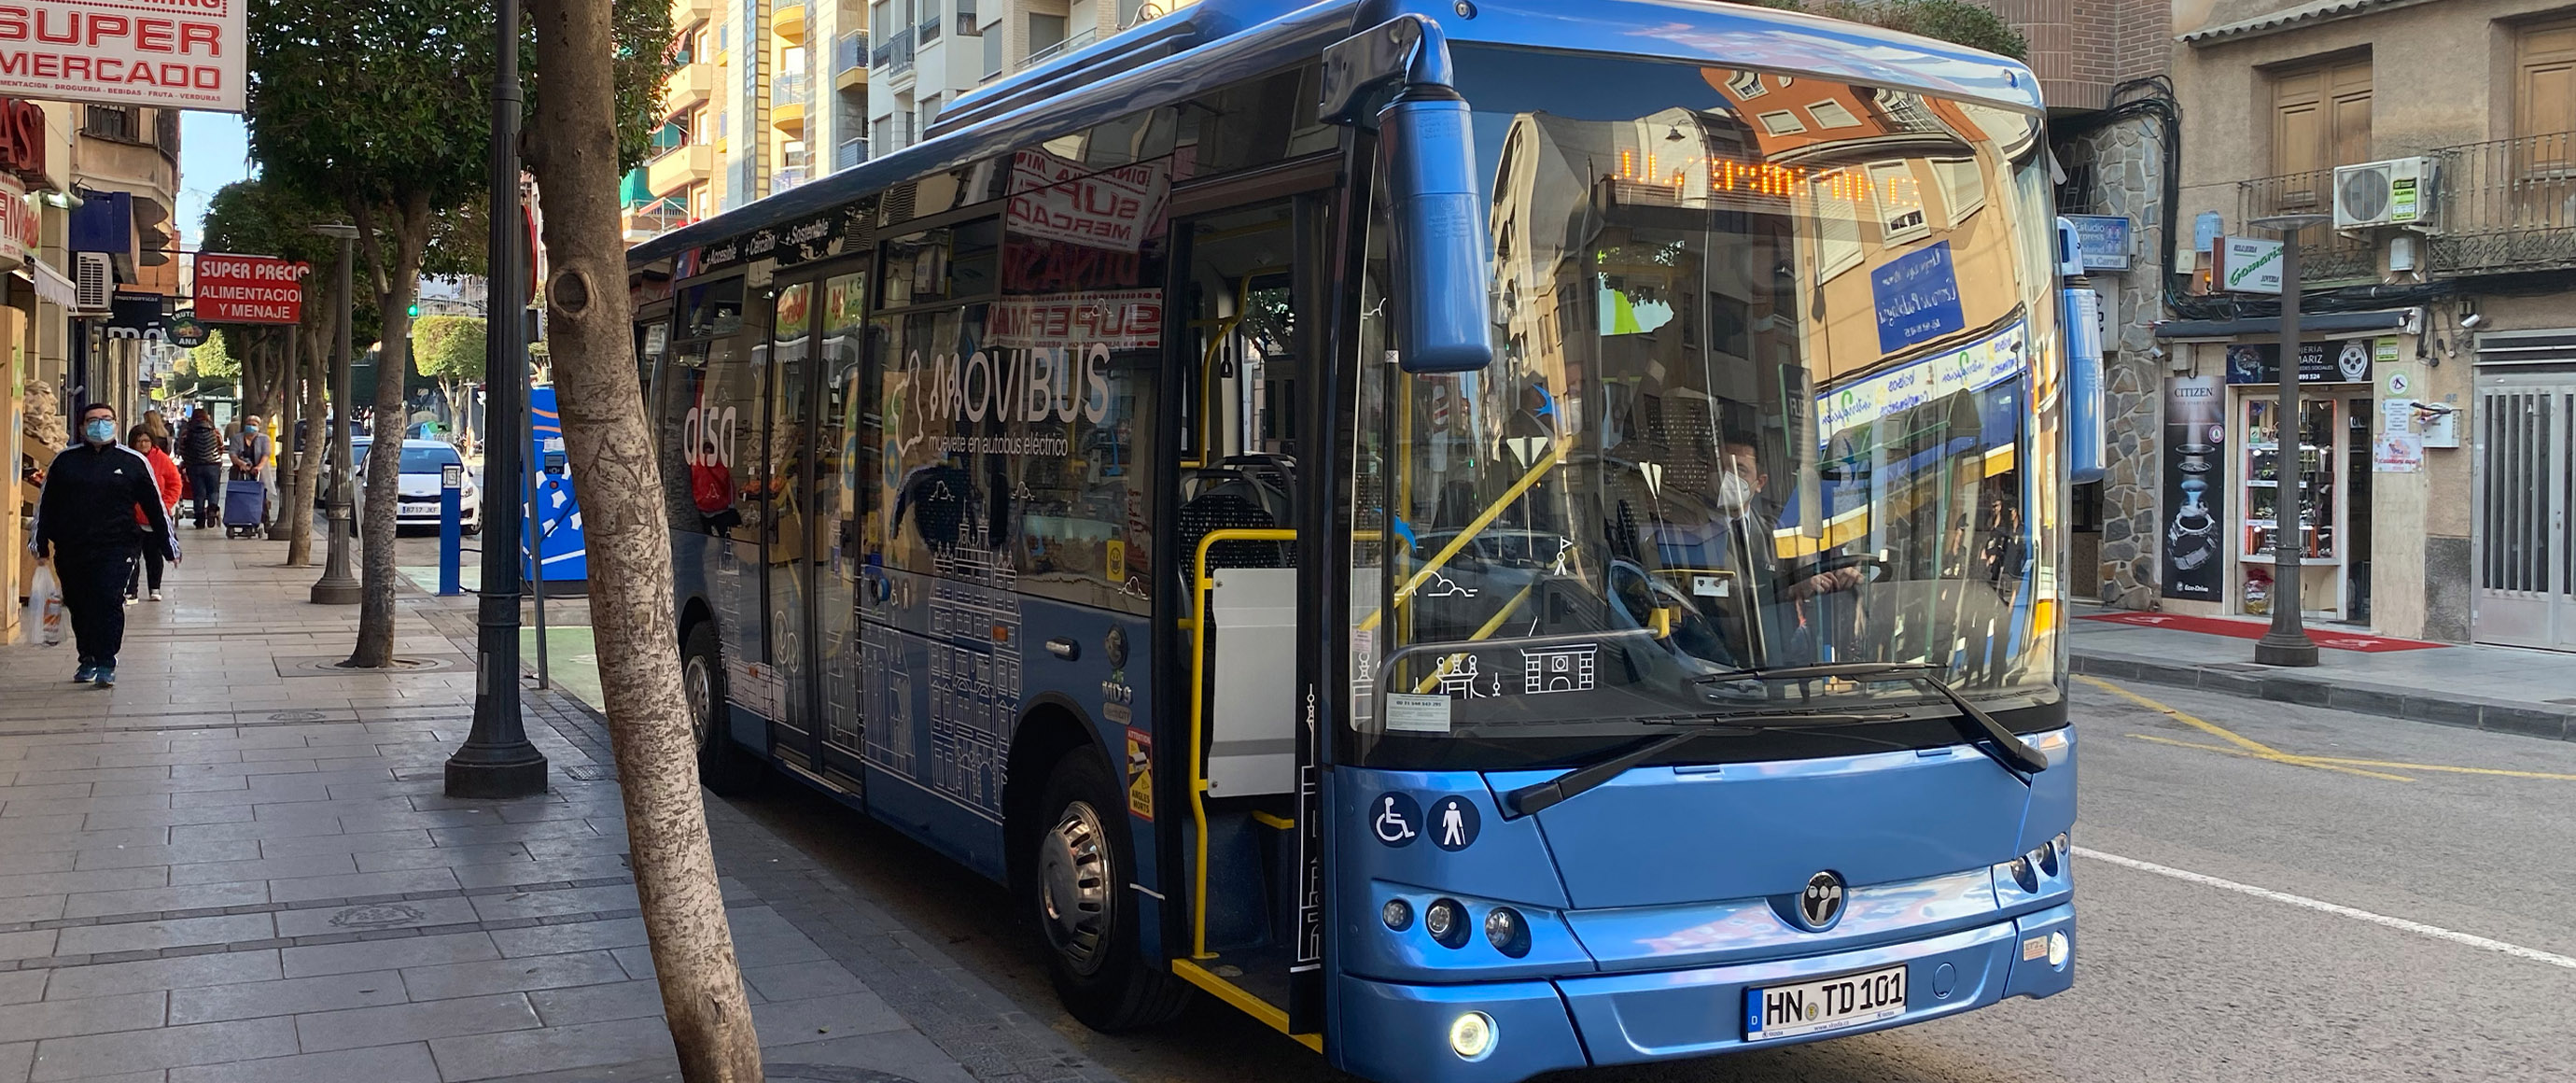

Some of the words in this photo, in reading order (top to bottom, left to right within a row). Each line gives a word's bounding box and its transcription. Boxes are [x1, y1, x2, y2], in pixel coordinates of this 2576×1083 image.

[0, 6, 222, 57] SUPER
[0, 50, 222, 91] MERCADO
[55, 84, 101, 93] DROGUERIA
[108, 88, 142, 96] BEBIDAS
[179, 93, 221, 102] VERDURAS
[791, 218, 829, 245] Sostenible
[2075, 222, 2105, 232] Estudio
[201, 260, 250, 279] SUPER
[200, 285, 302, 303] ALIMENTACIO
[218, 303, 229, 316] Y
[231, 303, 290, 319] MENAJE
[2299, 345, 2323, 354] JERÍA
[2300, 355, 2323, 364] ARIZ
[930, 343, 1111, 424] MOVIBUS
[2175, 387, 2213, 397] CITIZEN
[684, 393, 736, 468] alsa
[929, 431, 966, 453] muévete
[968, 437, 980, 454] en
[982, 432, 1022, 455] autobús
[1024, 431, 1069, 457] eléctrico
[1132, 790, 1150, 804] ANGLES
[1133, 801, 1150, 814] MORTS
[1766, 990, 1803, 1025] HN
[1752, 1016, 1758, 1025] D
